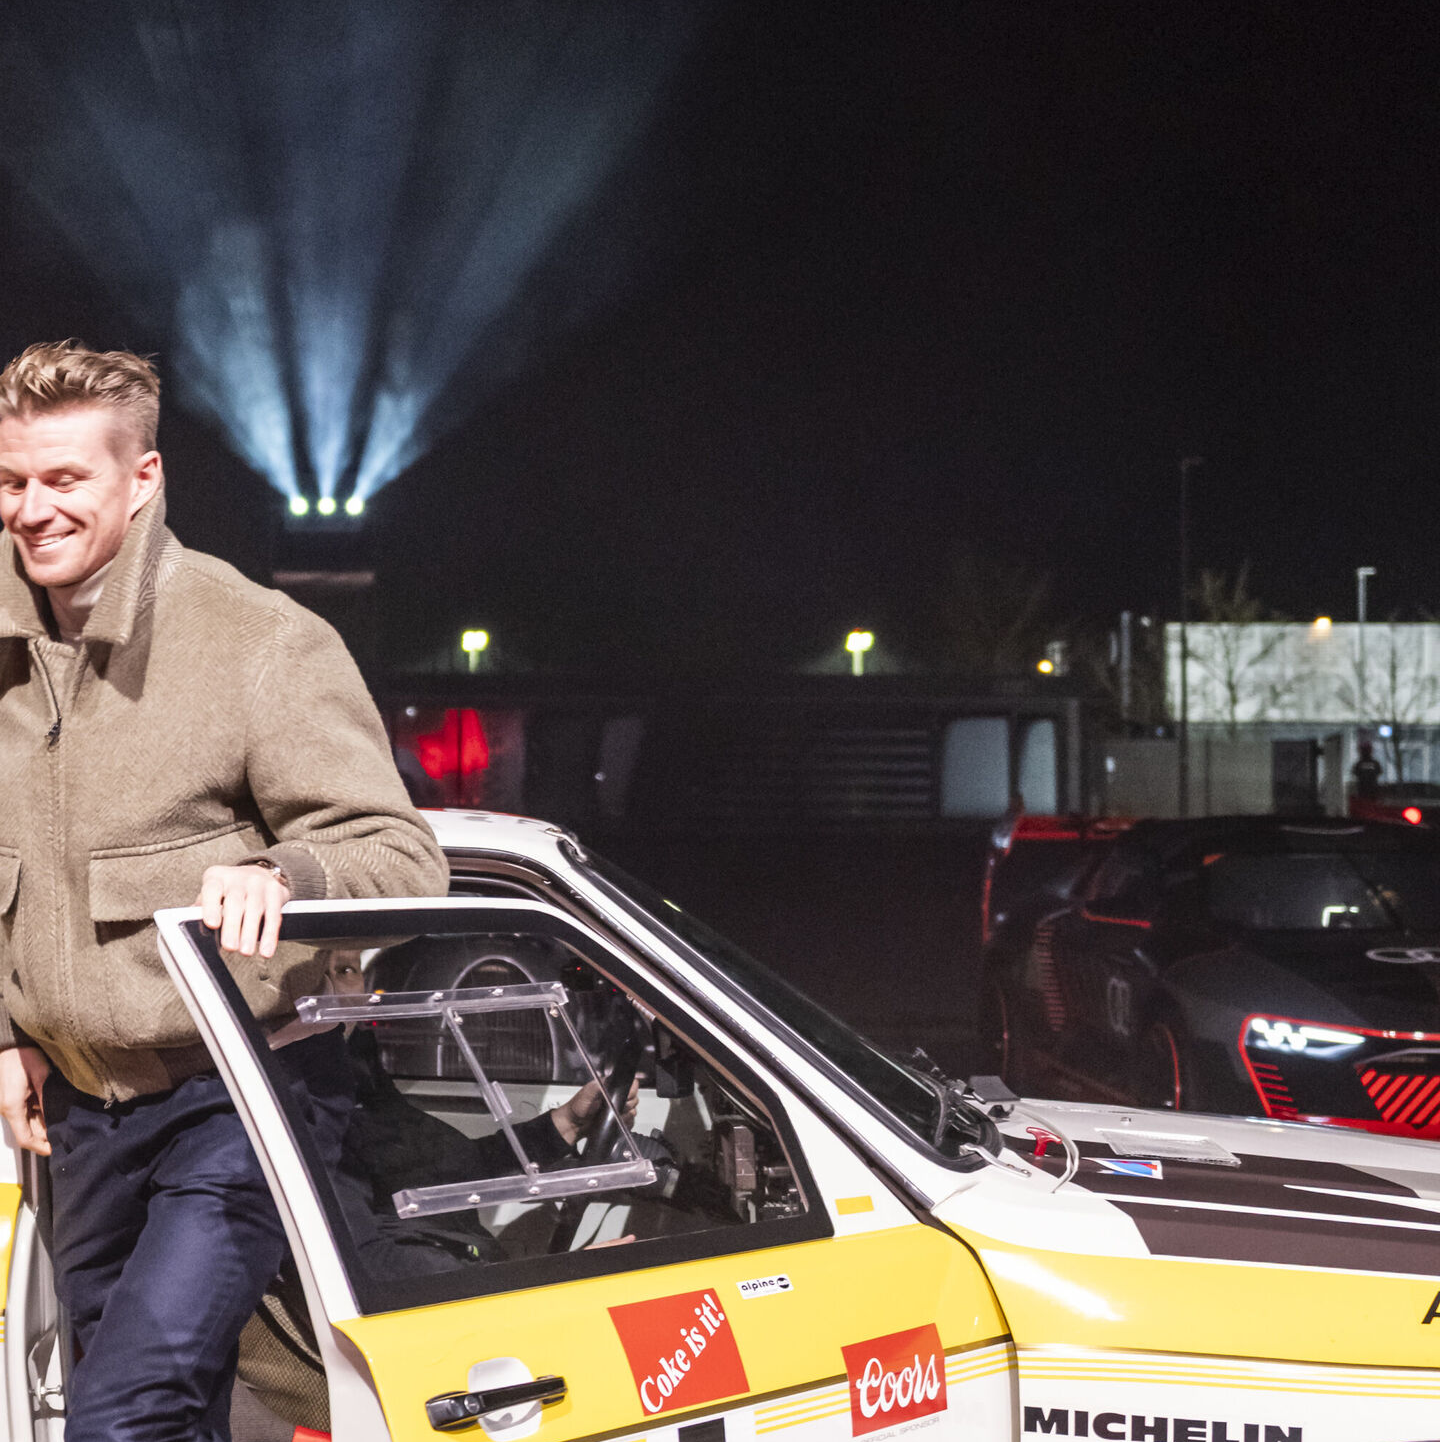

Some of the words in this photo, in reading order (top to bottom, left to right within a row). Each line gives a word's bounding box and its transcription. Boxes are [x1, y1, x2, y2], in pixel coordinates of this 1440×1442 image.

[640, 1349, 691, 1413] Coke
[680, 1327, 707, 1358] is
[694, 1293, 725, 1337] it!
[855, 1354, 941, 1418] Coors
[900, 1417, 940, 1433] SPONSOR
